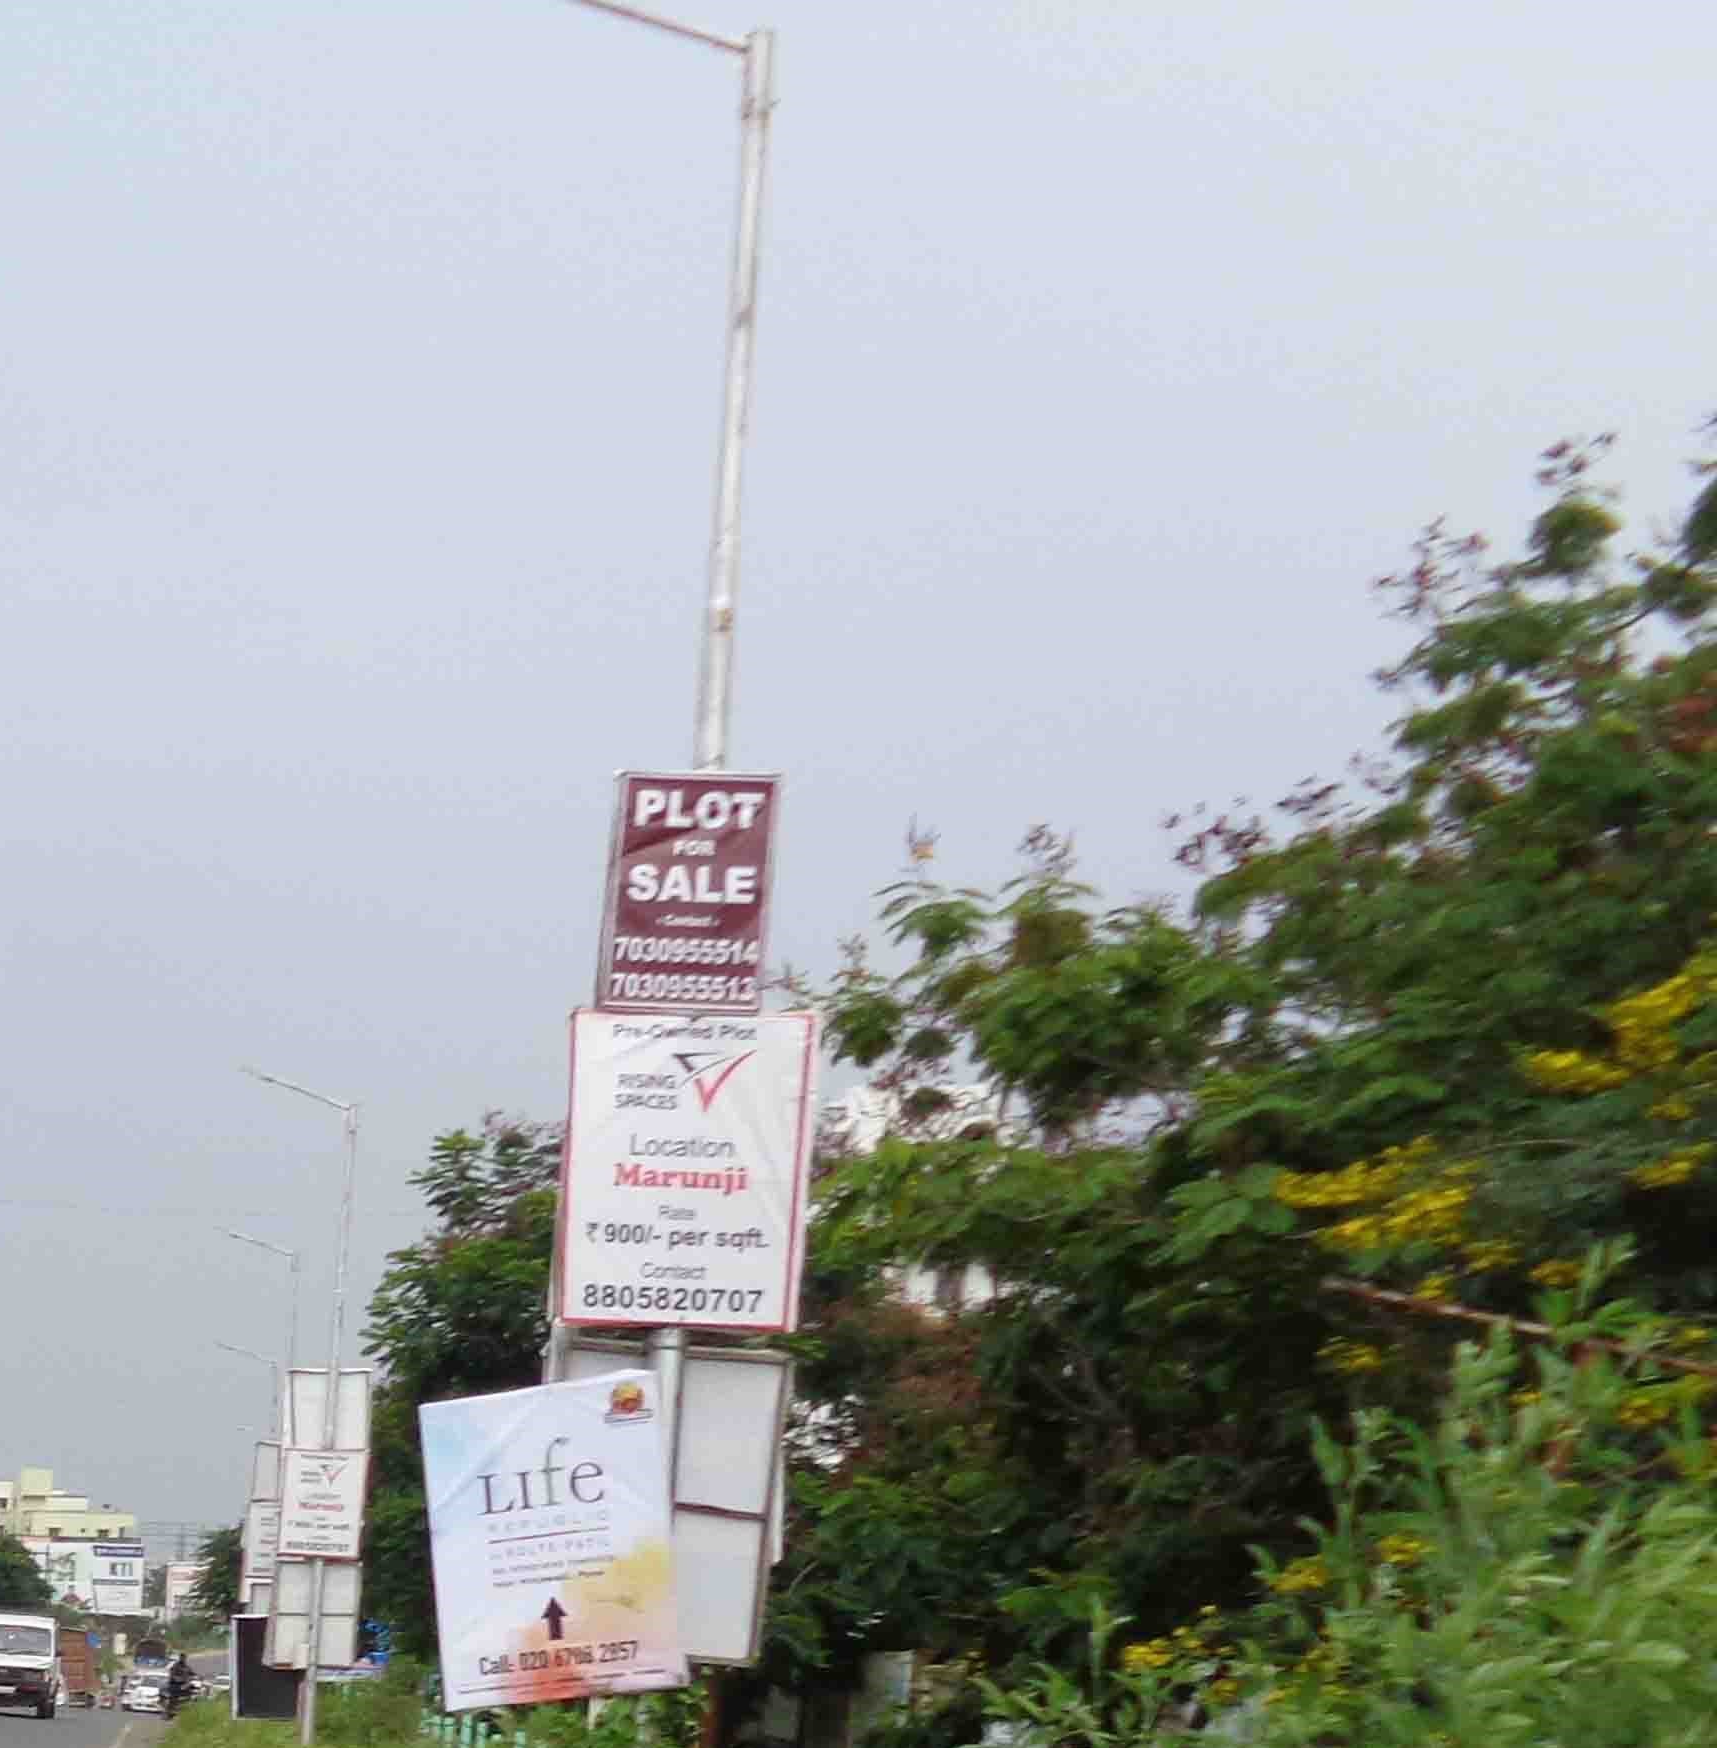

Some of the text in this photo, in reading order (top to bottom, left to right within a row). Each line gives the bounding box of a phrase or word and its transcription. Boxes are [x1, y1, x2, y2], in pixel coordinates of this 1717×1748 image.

[633, 789, 766, 829] PLOT
[672, 840, 716, 856] FOR
[627, 863, 758, 904] SALE
[718, 1025, 758, 1040] Plot
[617, 1073, 678, 1089] RISING
[613, 1094, 678, 1111] SPACES
[629, 1133, 737, 1158] Location
[612, 1163, 750, 1195] Marunji
[604, 1223, 663, 1244] 900/-
[668, 1229, 711, 1250] per
[639, 1262, 708, 1281] Contact
[582, 1283, 764, 1313] 8805820707
[476, 1436, 605, 1515] Life
